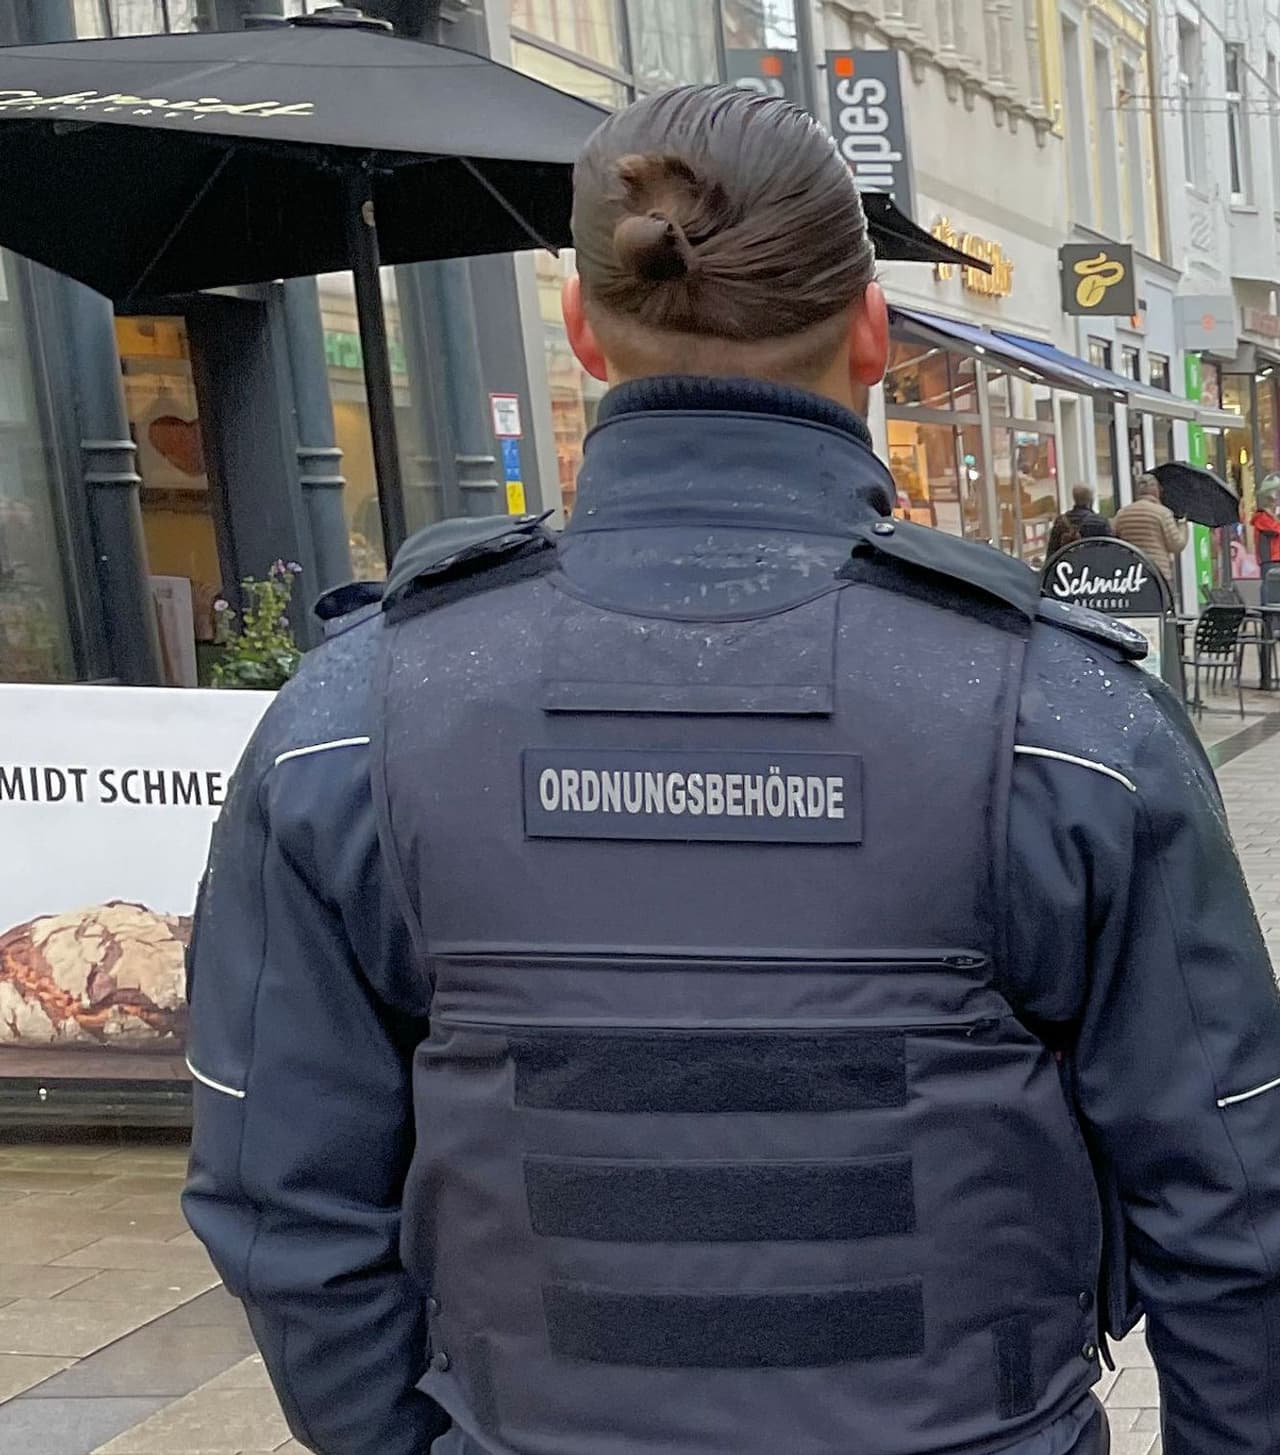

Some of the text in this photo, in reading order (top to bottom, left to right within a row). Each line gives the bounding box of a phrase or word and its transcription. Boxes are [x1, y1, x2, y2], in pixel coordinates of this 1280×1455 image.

[1052, 561, 1148, 597] Schmidt
[0, 766, 88, 803] MIDT
[539, 766, 845, 819] ORDNUNGSBEHÖRDE
